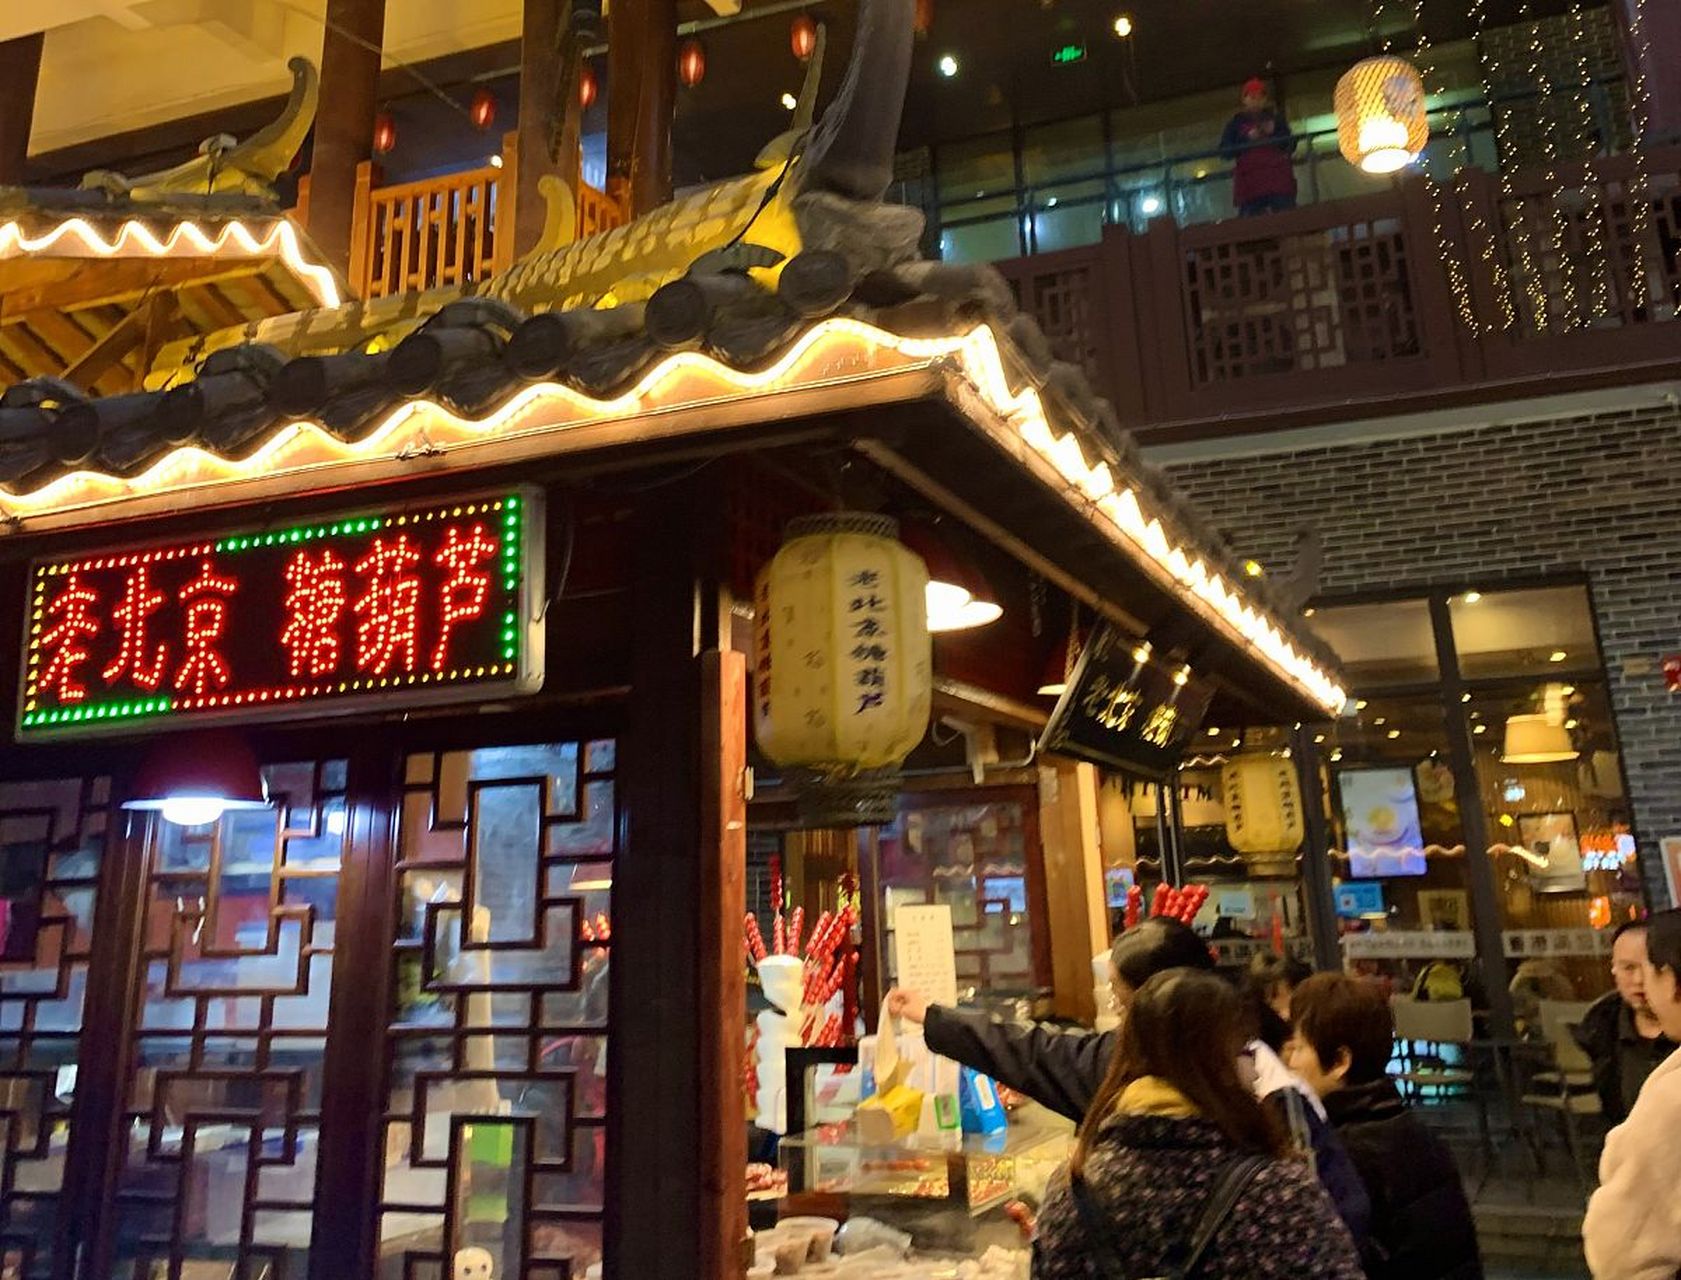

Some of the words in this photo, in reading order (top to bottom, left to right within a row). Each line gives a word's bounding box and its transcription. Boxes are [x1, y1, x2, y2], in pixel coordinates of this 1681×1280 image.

[38, 562, 237, 702] 老北京
[281, 523, 497, 678] 糖葫芦
